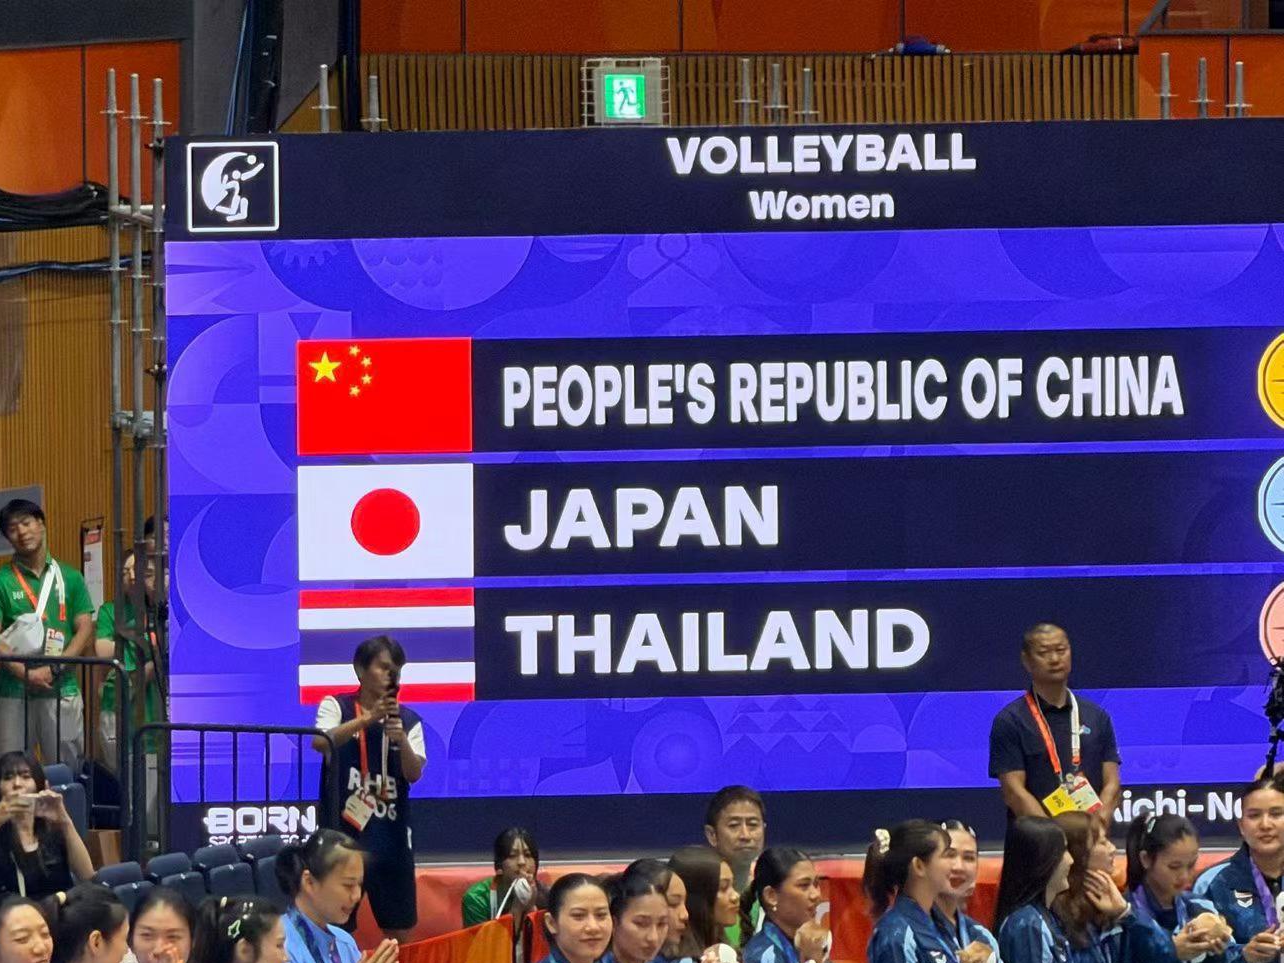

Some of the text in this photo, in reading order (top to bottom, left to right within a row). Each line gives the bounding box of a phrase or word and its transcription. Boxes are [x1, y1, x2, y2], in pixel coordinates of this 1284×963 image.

[667, 133, 976, 174] VOLLEYBALL
[749, 191, 894, 220] Women
[504, 355, 1184, 427] PEOPLE'S REPUBLIC OF CHINA
[504, 486, 779, 551] JAPAN
[504, 608, 930, 675] THAILAND
[204, 806, 318, 834] BORN
